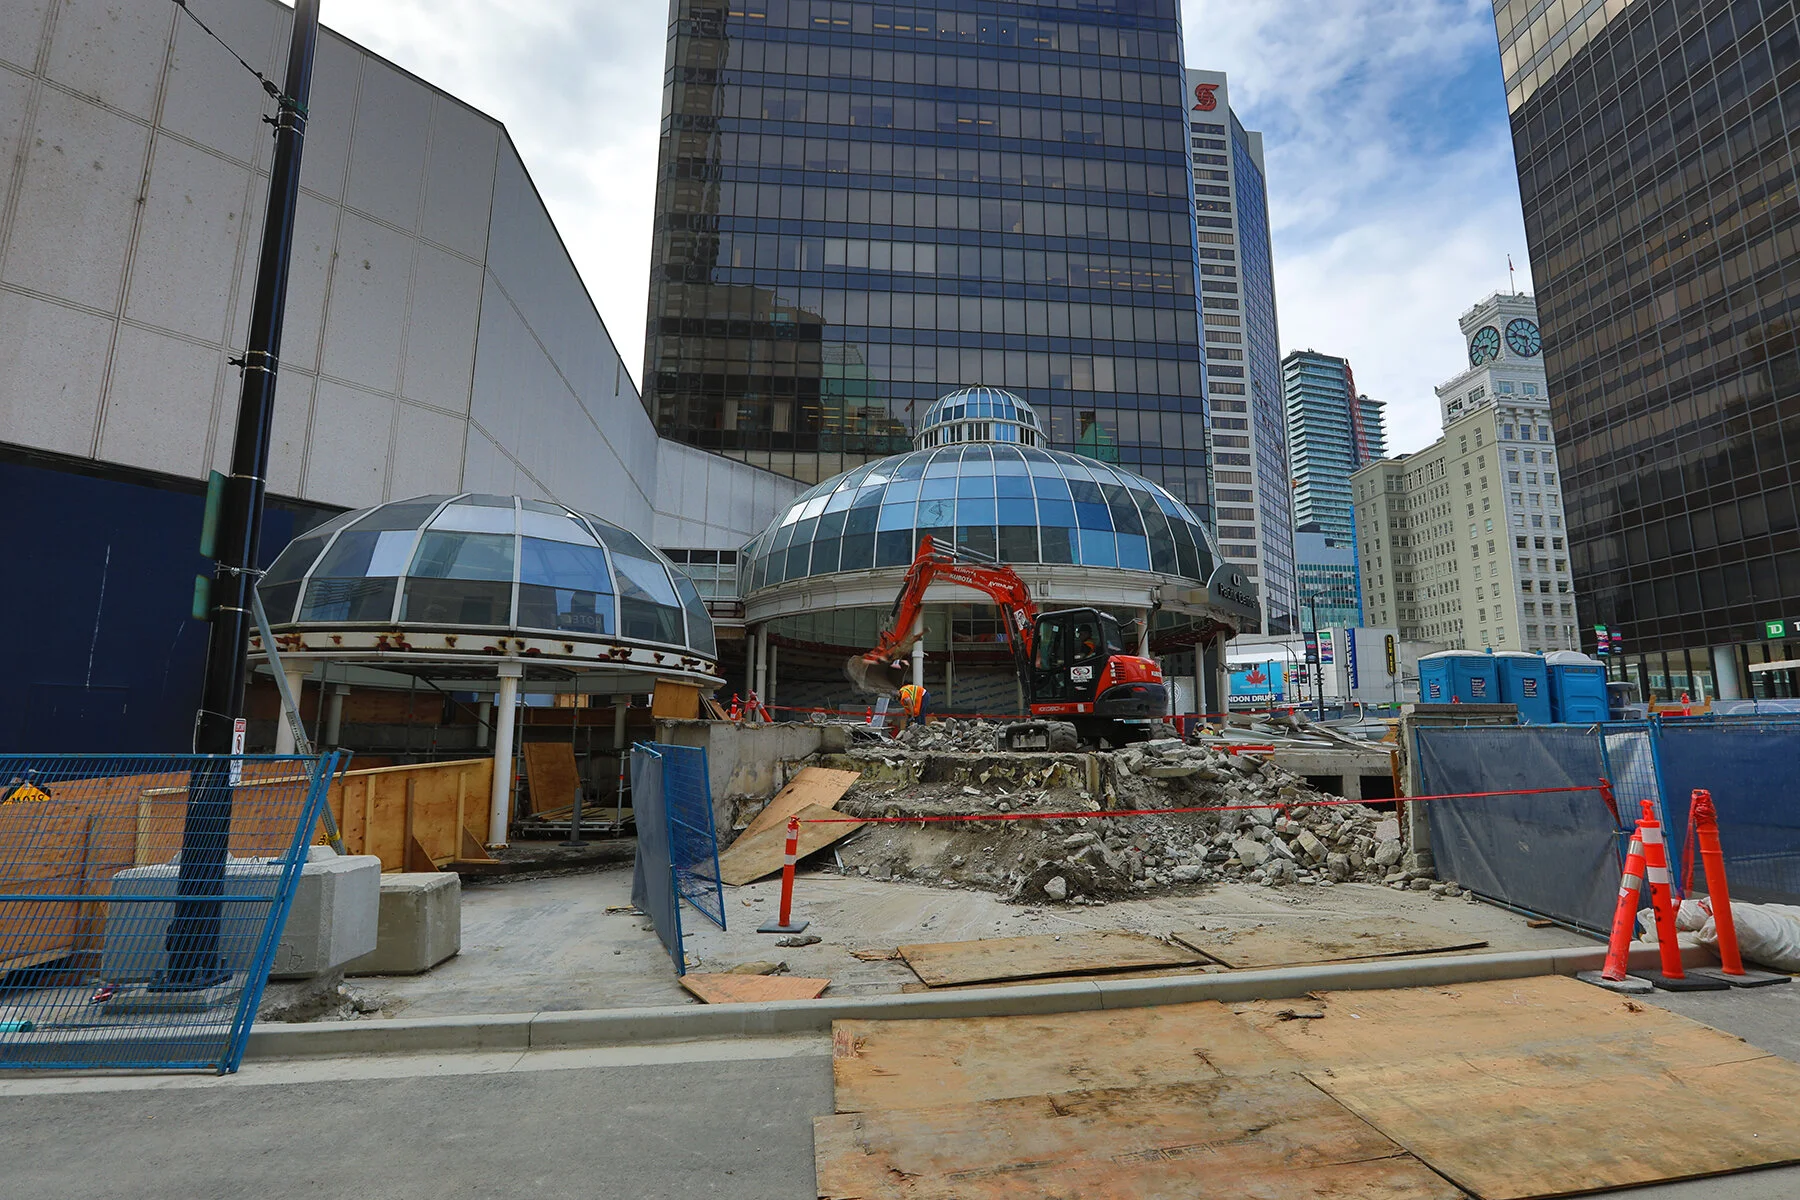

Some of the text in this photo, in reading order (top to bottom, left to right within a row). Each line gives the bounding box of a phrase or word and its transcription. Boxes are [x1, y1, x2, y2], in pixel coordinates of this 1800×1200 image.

[949, 573, 973, 584] KUBOTA
[1218, 583, 1238, 601] Pacific
[1767, 624, 1783, 634] TD
[1793, 621, 1800, 632] T
[1228, 695, 1251, 703] NDON
